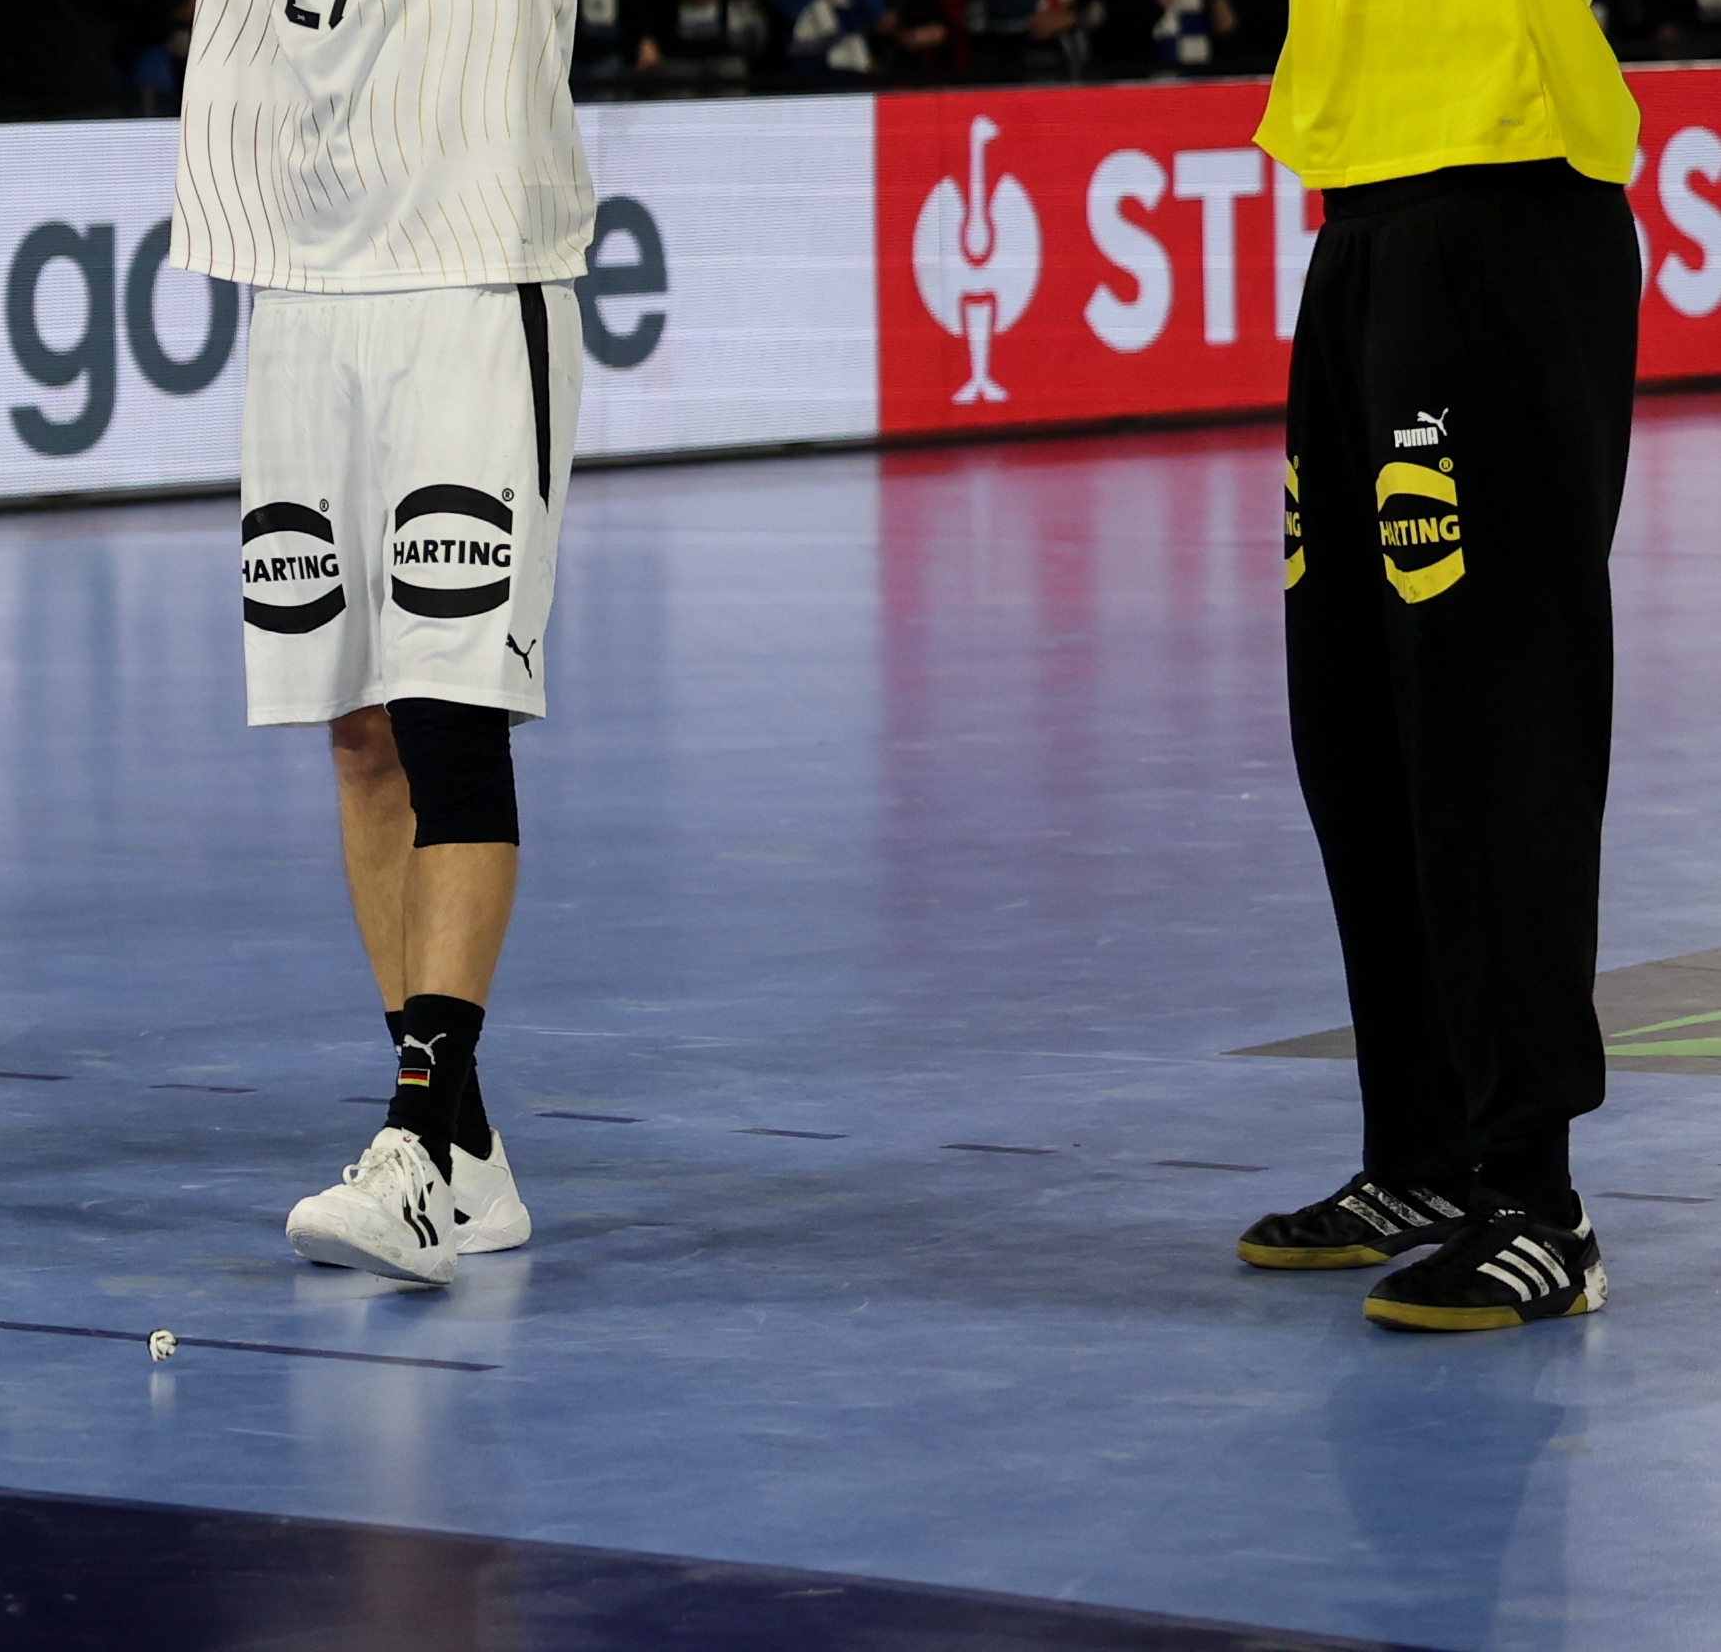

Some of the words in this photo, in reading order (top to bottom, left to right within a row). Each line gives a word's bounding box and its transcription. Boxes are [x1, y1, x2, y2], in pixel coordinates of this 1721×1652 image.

[1393, 426, 1439, 448] PUMA
[1379, 514, 1461, 546] HARTING
[242, 553, 340, 583] HARTING
[393, 539, 511, 568] HARTING
